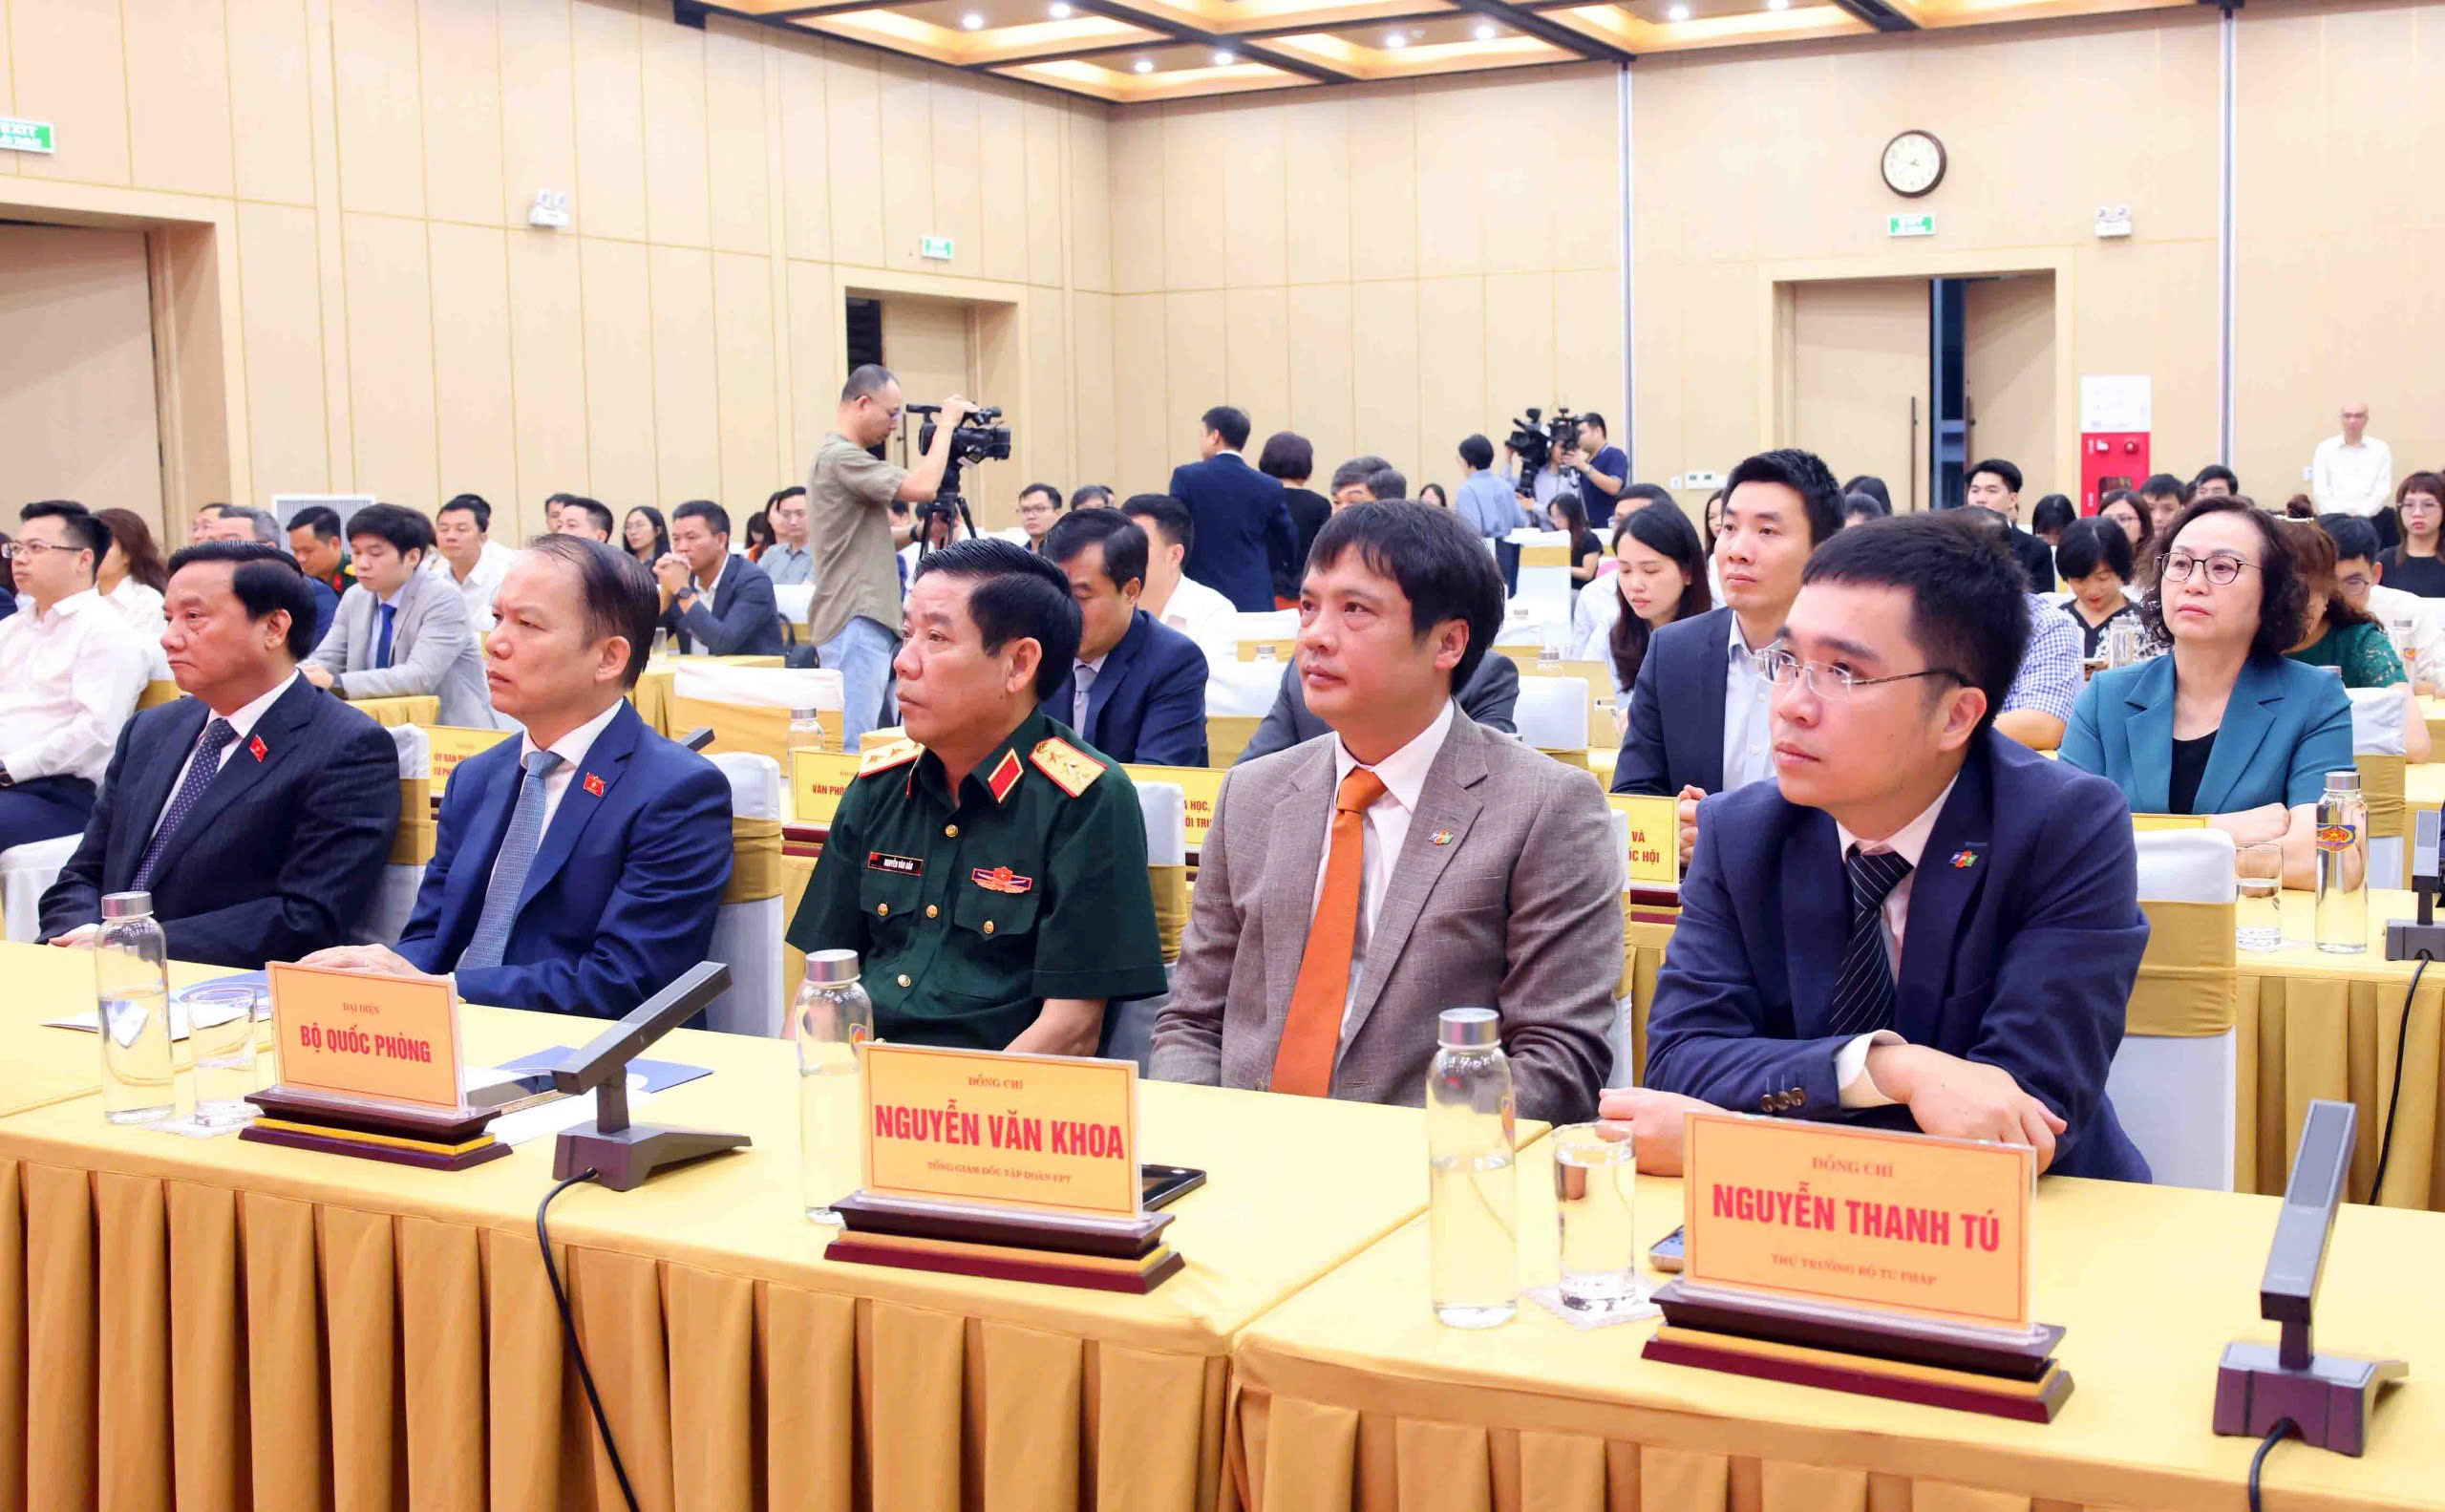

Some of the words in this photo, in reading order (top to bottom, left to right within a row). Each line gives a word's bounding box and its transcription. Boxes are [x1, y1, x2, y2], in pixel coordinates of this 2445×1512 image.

[1643, 849, 1659, 864] HỘI
[300, 1021, 322, 1054] BỘ
[327, 1024, 371, 1054] QUỐC
[374, 1032, 432, 1063] PHÒNG
[875, 1098, 980, 1146] NGUYỄN
[988, 1109, 1042, 1152] VĂN
[1052, 1119, 1125, 1160] KHOA
[1053, 1173, 1071, 1183] FPT
[1712, 1181, 1835, 1232] NGUYỄN
[1845, 1200, 1950, 1246] THANH
[1960, 1208, 2001, 1253] TÚ
